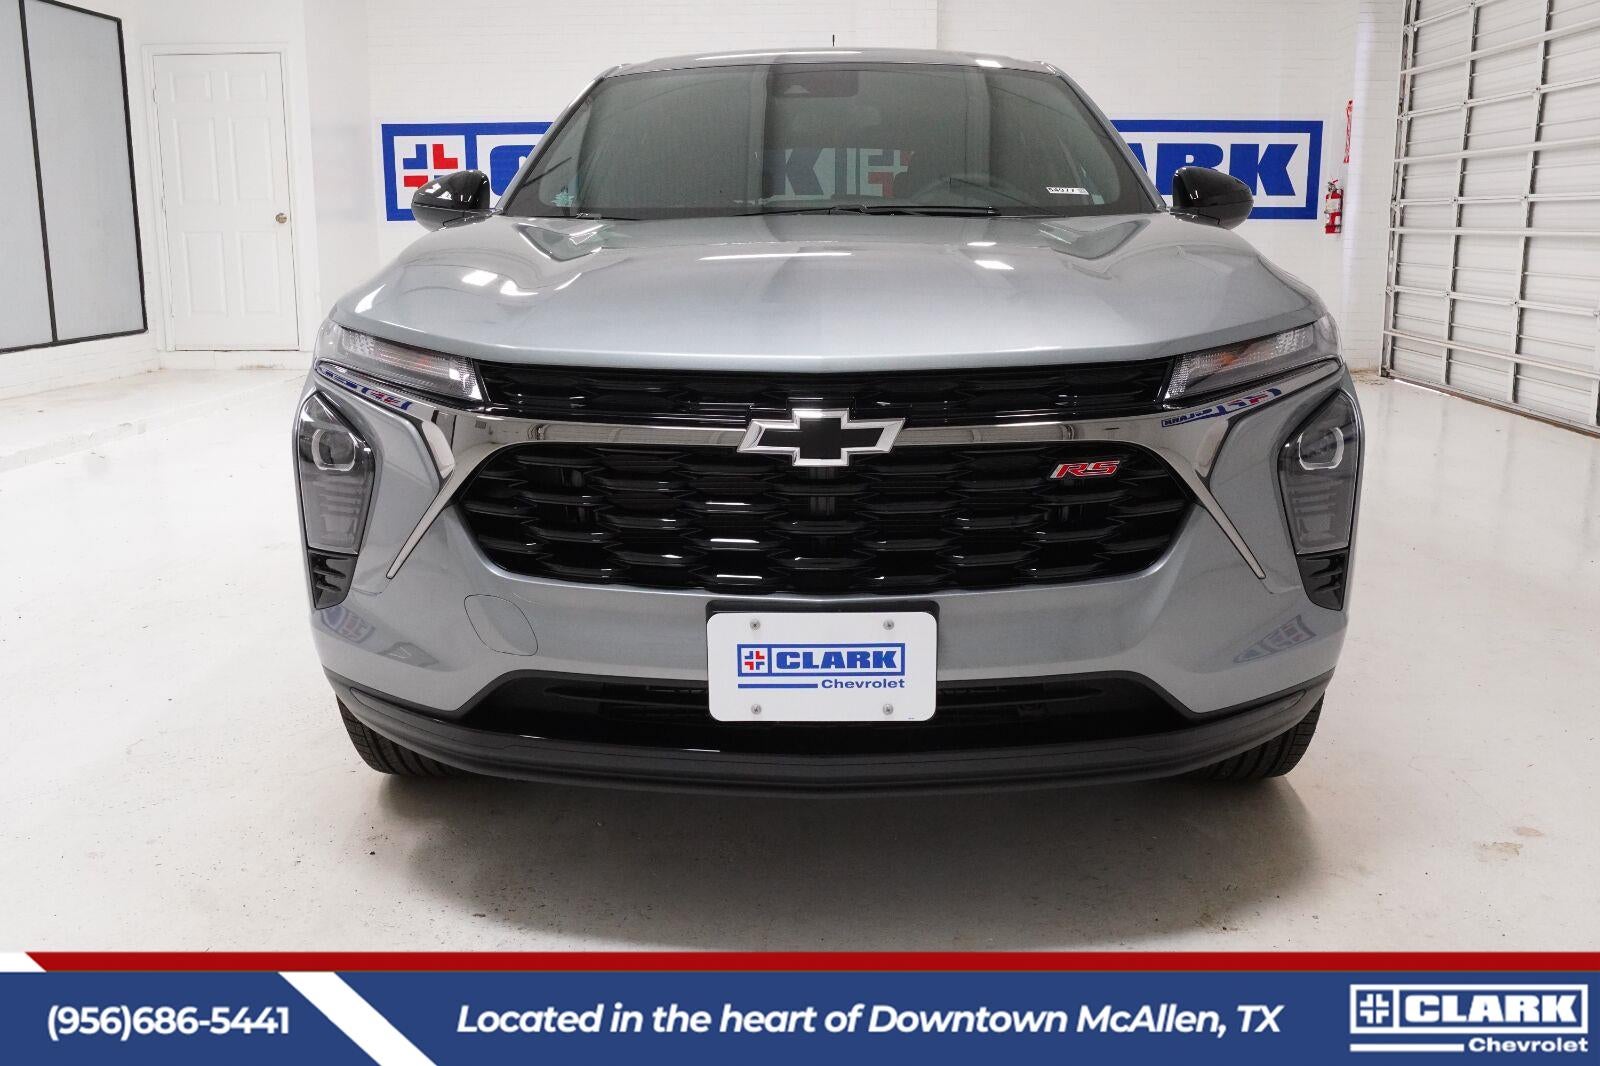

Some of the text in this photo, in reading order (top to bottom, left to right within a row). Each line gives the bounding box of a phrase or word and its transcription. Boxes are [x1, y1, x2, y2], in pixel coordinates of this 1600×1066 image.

[1050, 461, 1120, 479] RS
[776, 651, 896, 669] CLARK
[821, 679, 905, 689] Chevrolet
